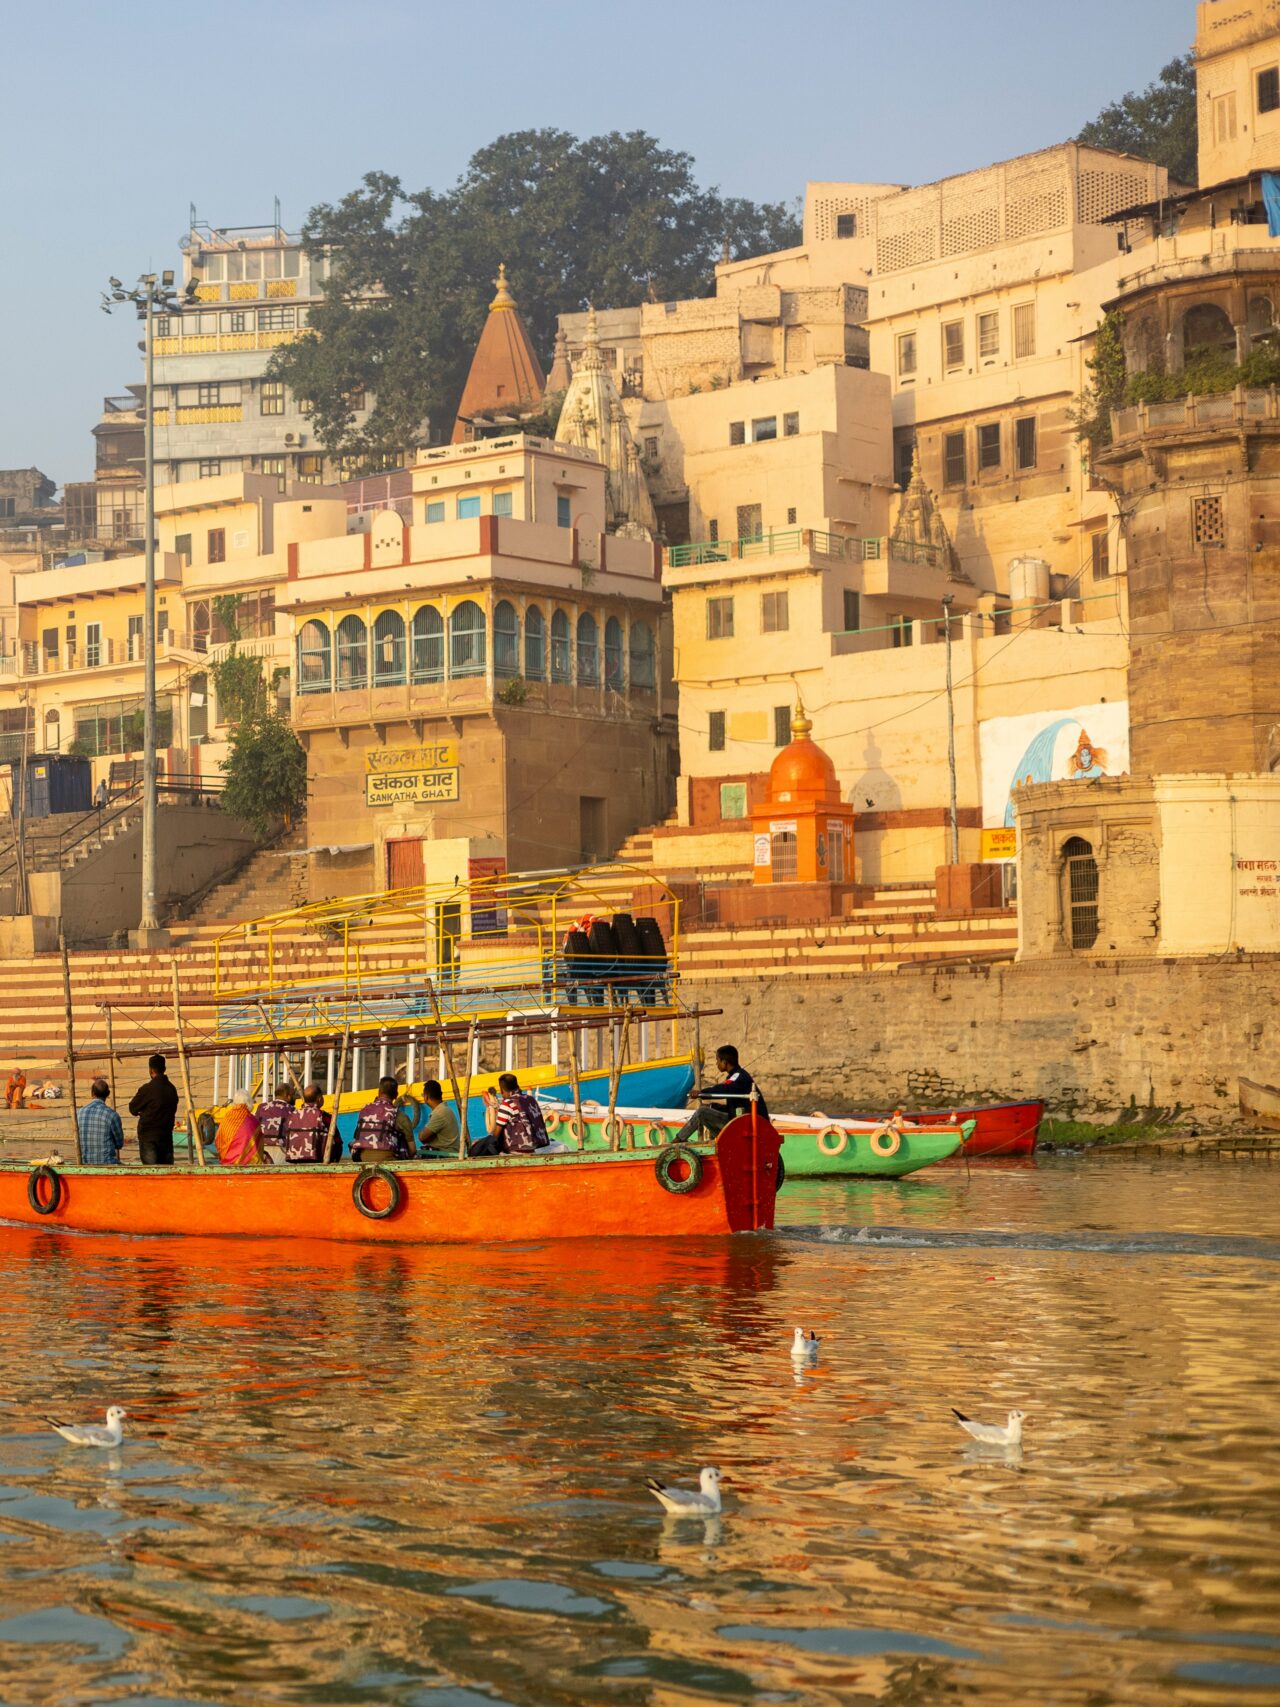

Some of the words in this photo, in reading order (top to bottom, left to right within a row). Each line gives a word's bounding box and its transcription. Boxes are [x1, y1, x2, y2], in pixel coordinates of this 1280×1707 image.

[372, 774, 419, 790] संकठा
[422, 773, 453, 787] घाट
[369, 791, 418, 803] SANKATHA
[421, 789, 453, 800] GHAT
